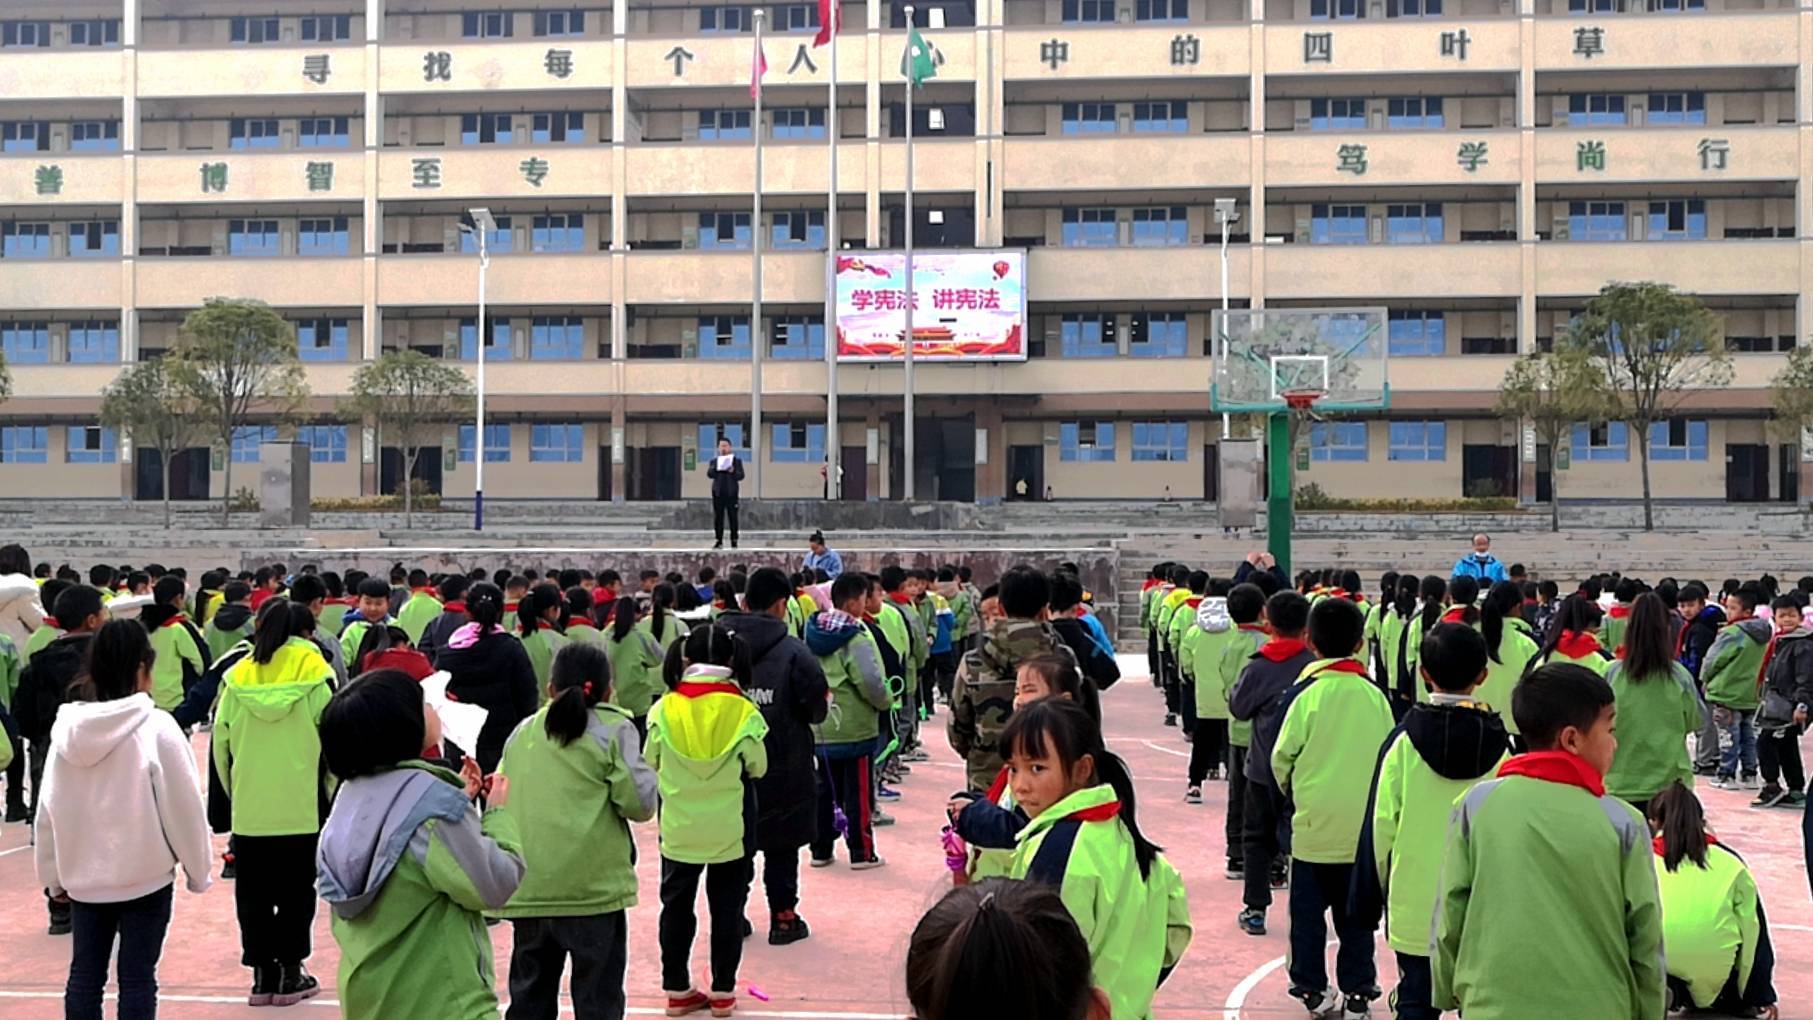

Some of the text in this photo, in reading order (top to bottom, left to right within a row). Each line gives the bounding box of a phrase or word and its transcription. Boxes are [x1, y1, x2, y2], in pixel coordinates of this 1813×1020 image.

[199, 156, 549, 194] 博智至专
[1336, 138, 1730, 176] 笃学尚行
[851, 287, 1000, 311] 学宪法 讲宪法
